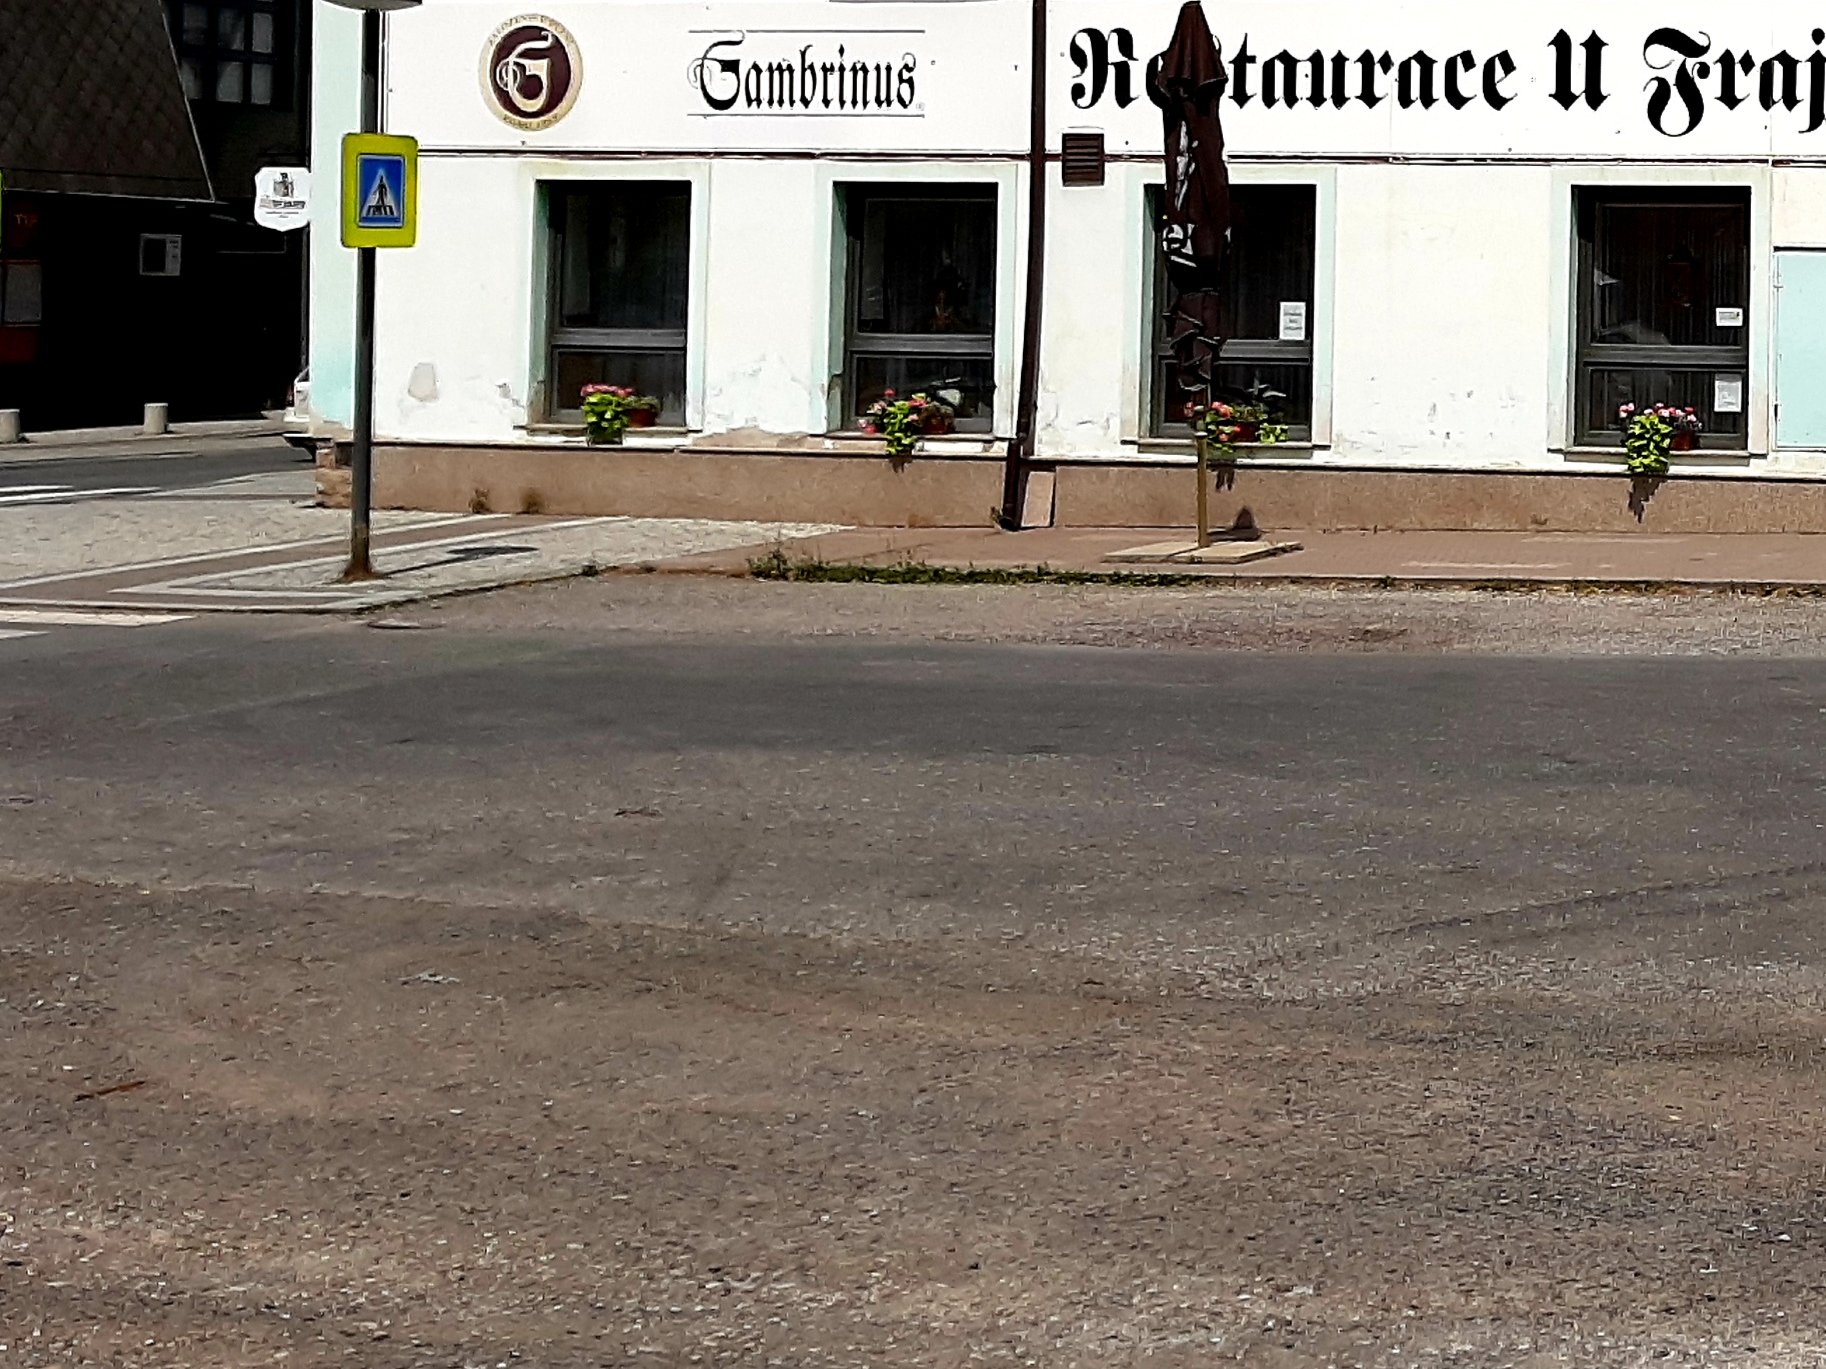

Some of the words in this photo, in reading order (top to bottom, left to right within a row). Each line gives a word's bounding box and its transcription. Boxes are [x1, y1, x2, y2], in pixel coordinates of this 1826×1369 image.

[687, 30, 917, 111] Gambrinus
[1070, 27, 1518, 111] Retaurace
[1547, 28, 1611, 112] U
